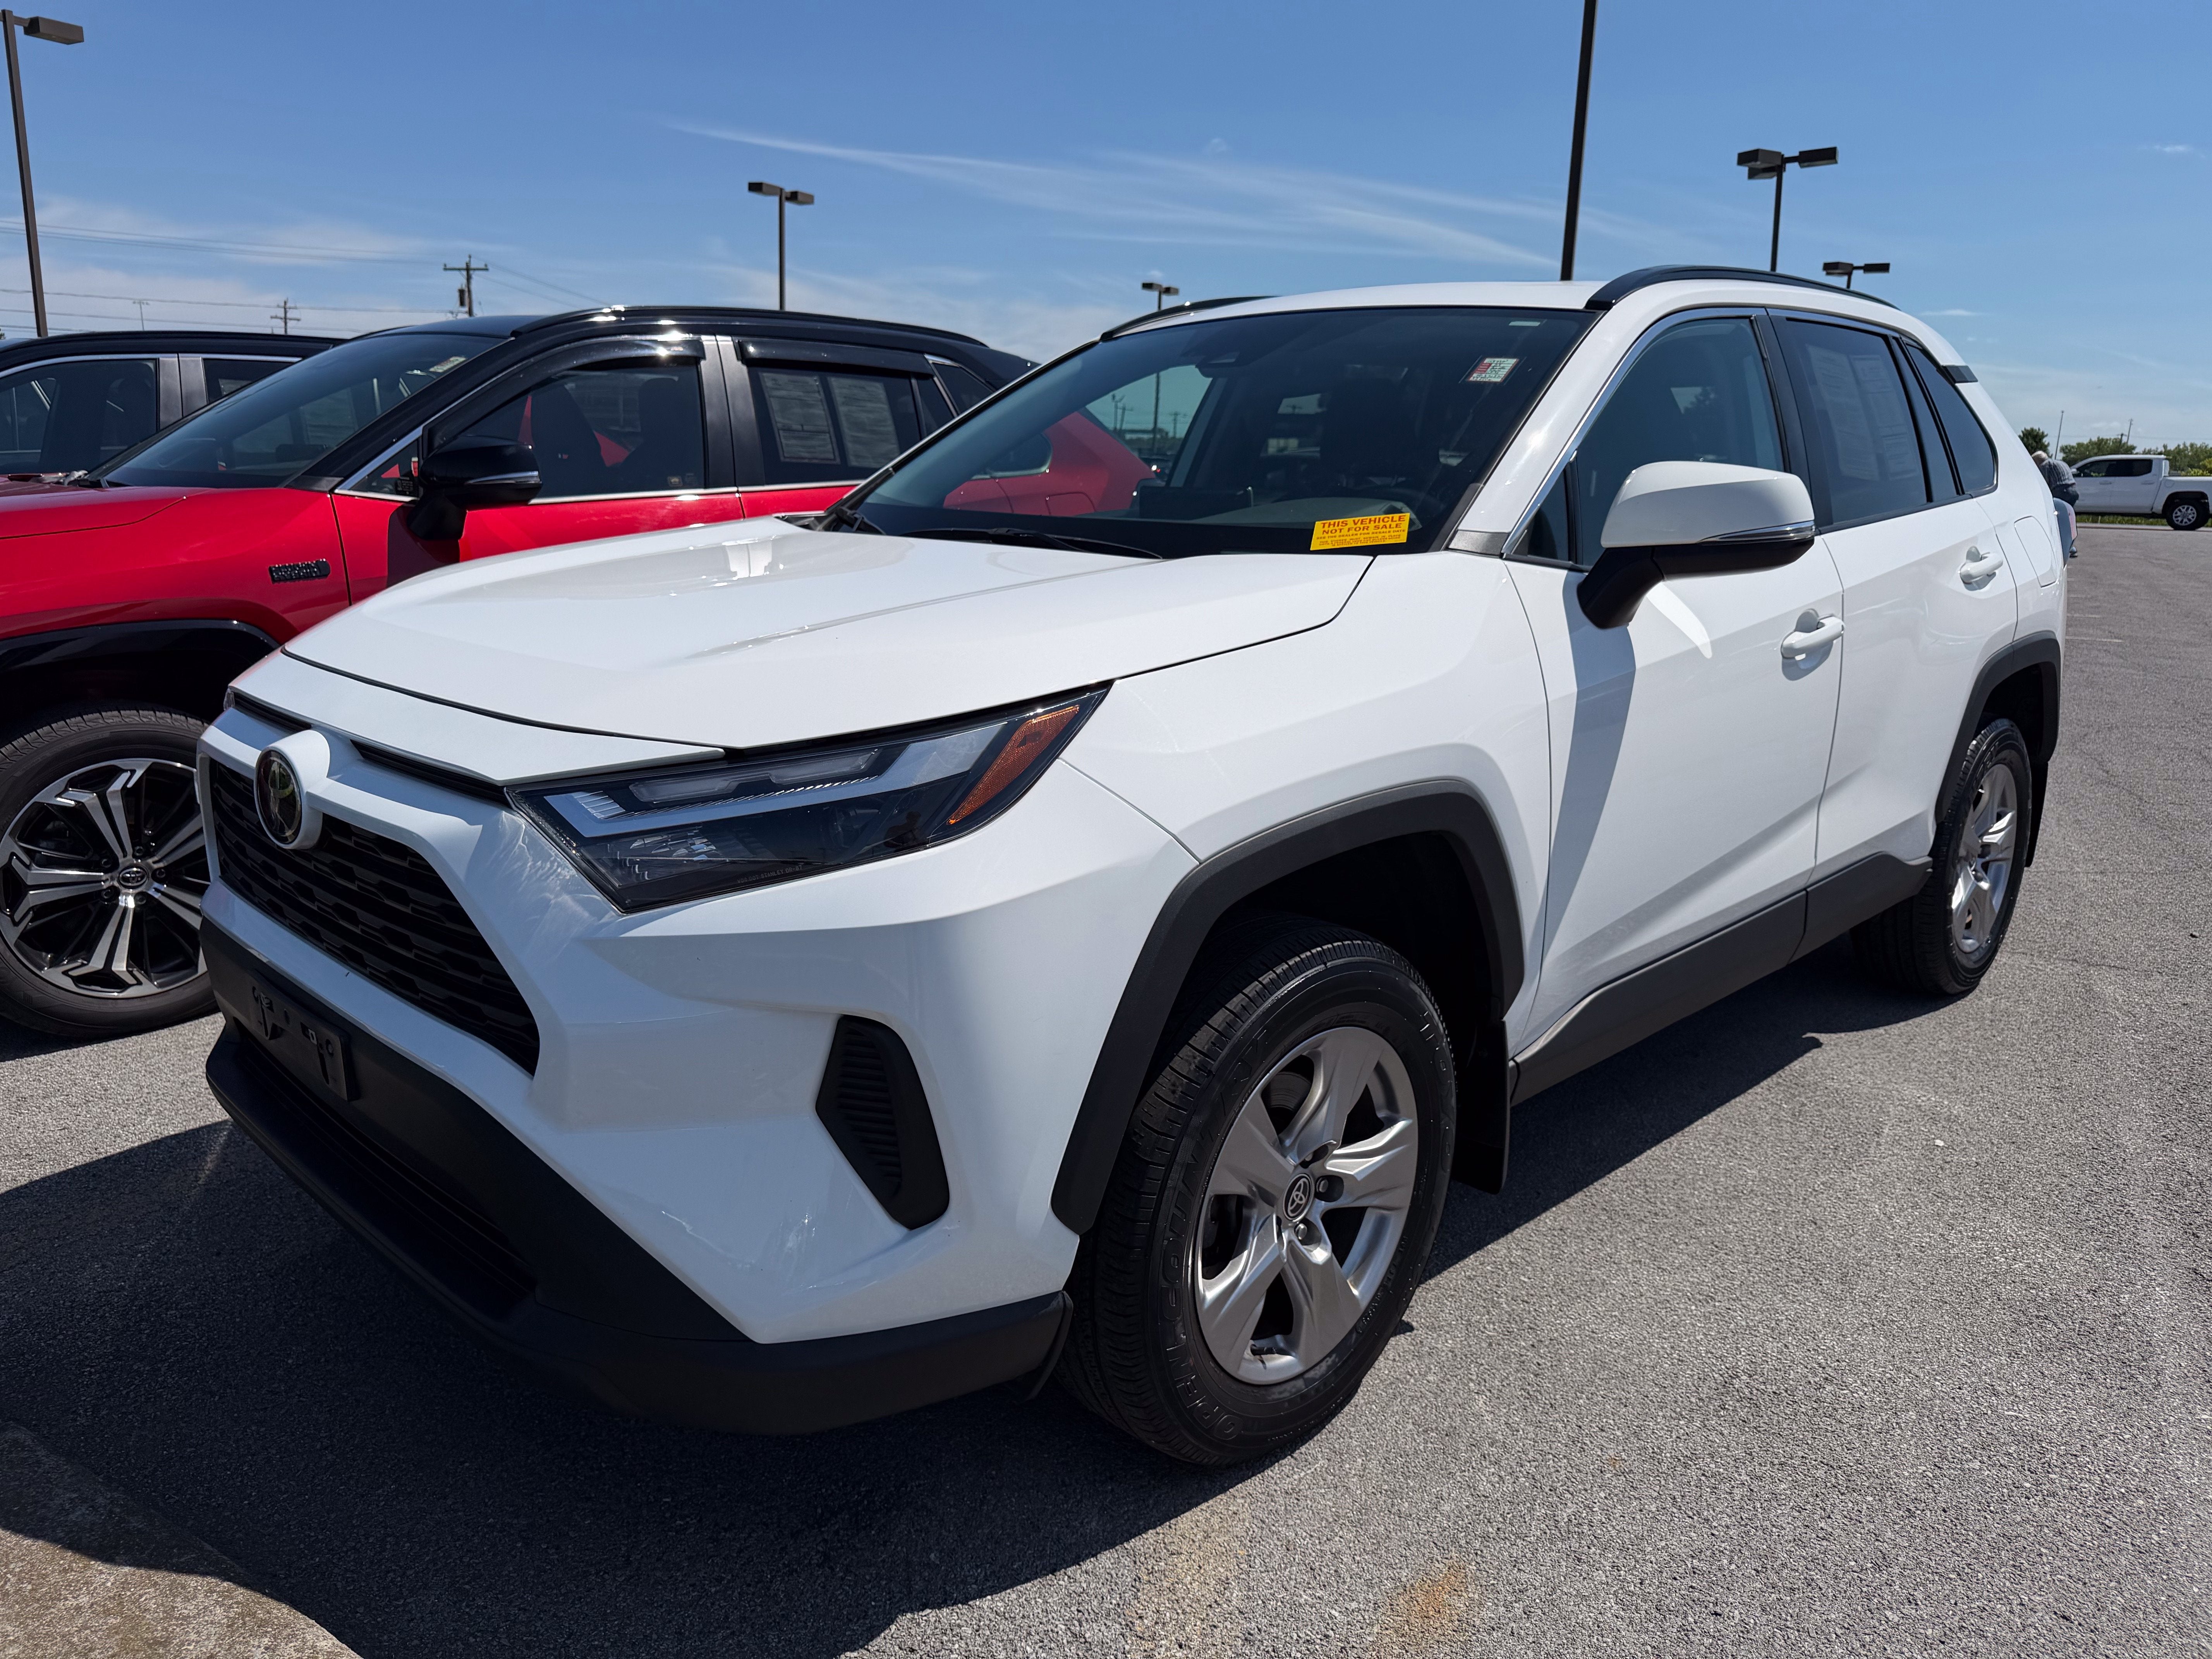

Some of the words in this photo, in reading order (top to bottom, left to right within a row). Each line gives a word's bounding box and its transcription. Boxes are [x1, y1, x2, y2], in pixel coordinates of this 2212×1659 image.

[1321, 520, 1348, 529] THIS
[1353, 515, 1406, 526] VEHICLE
[761, 869, 784, 879] STANLEY
[1166, 1342, 1243, 1441] OPEN
